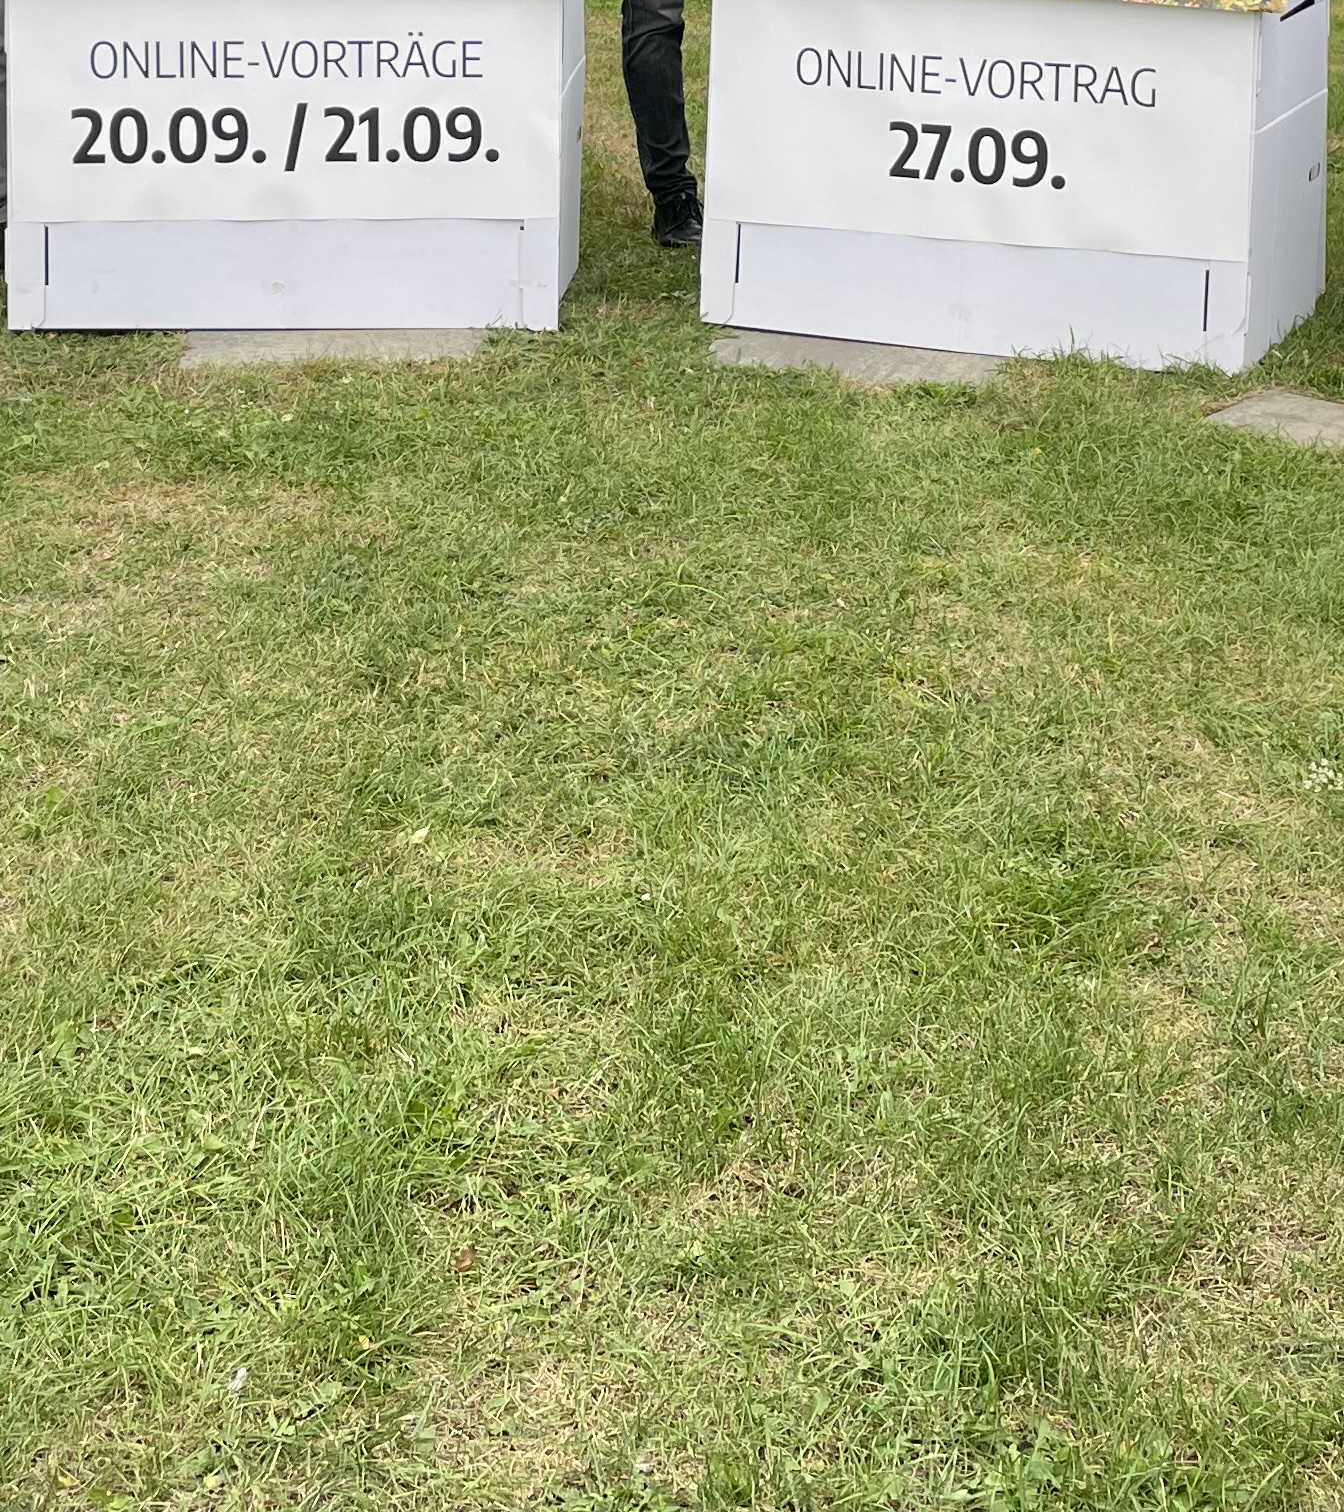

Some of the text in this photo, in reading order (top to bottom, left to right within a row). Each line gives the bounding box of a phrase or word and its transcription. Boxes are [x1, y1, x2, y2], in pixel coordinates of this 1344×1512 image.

[89, 31, 484, 80] ONLINE-VORTRÄGE
[795, 47, 1158, 108] ONLINE-VORTRAG
[71, 102, 500, 172] 20.09. / 21.09.
[888, 120, 1066, 190] 27.09.
